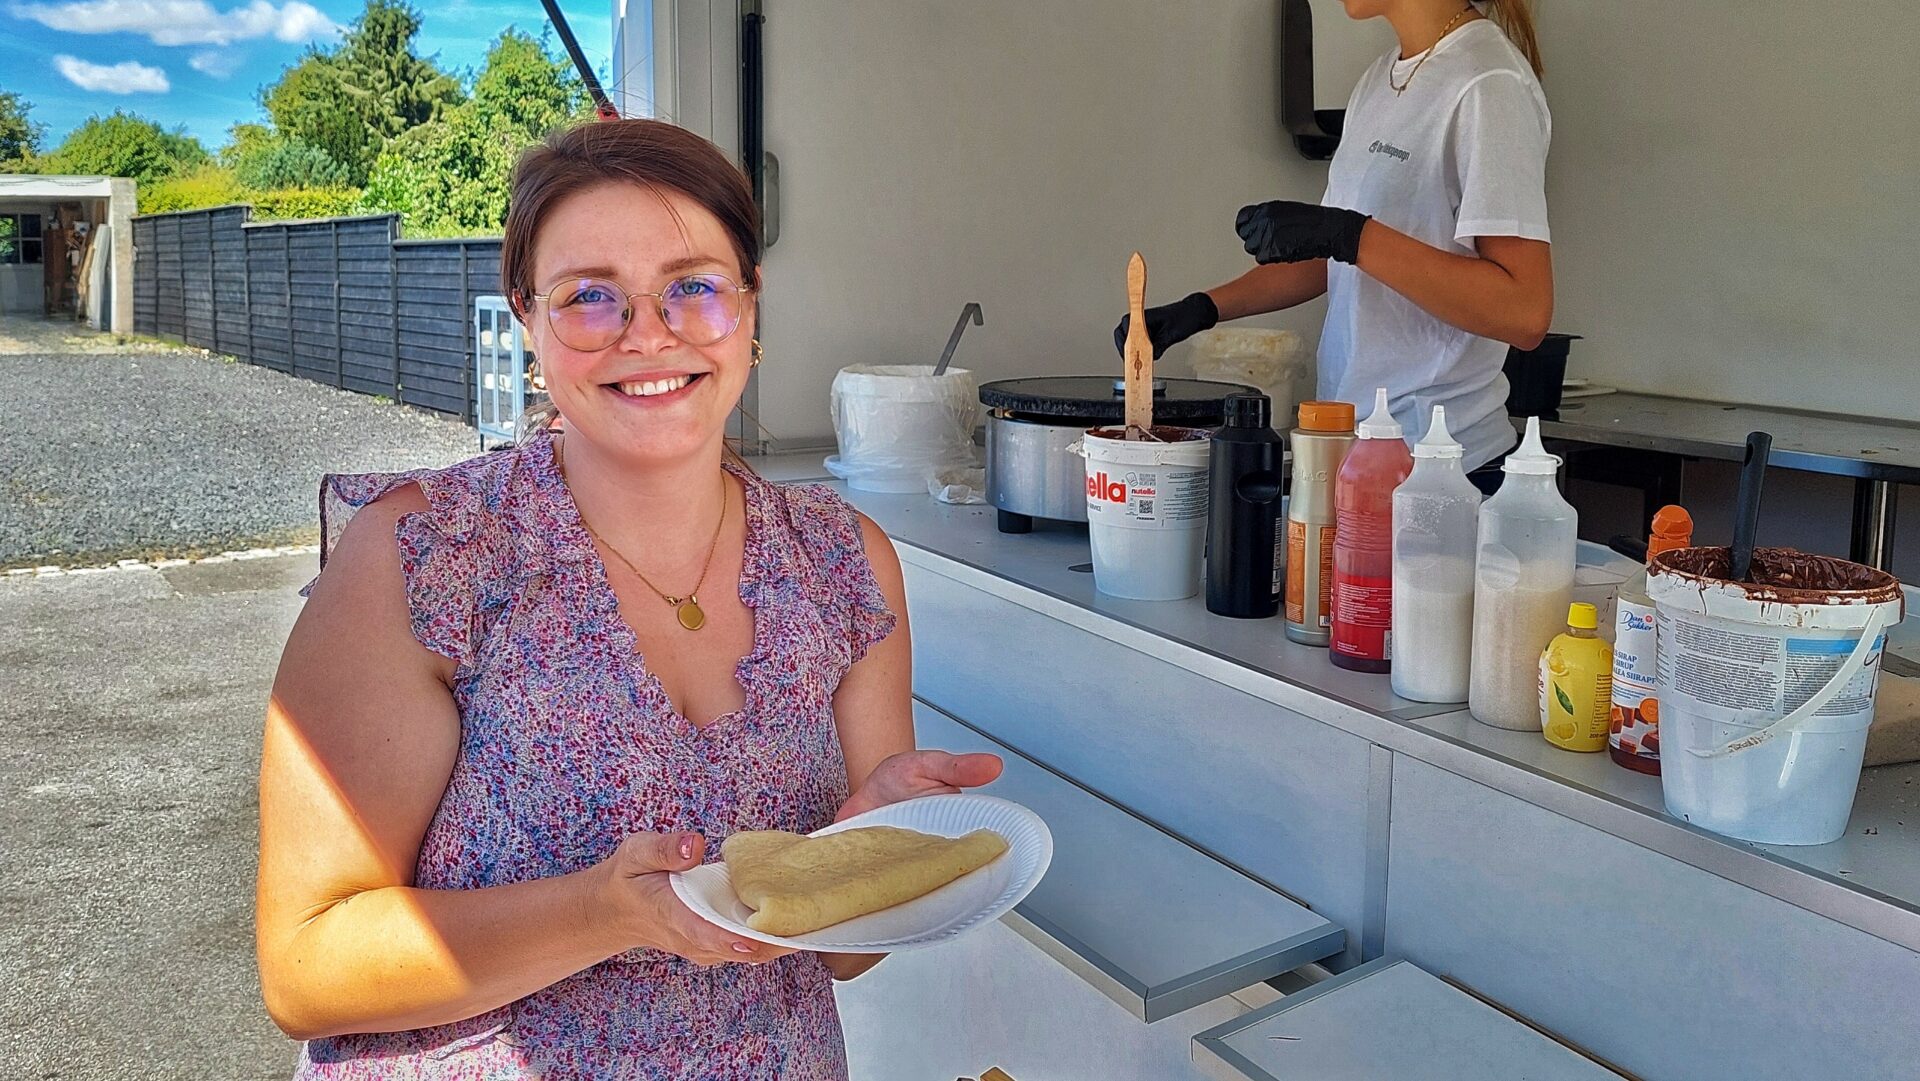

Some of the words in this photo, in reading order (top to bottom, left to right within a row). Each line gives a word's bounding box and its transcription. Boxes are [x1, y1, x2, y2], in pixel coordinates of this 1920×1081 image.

[1620, 610, 1643, 624] Dan
[1625, 621, 1654, 631] Sukker
[1618, 651, 1637, 662] SIRAP
[1616, 659, 1634, 670] SIRUP
